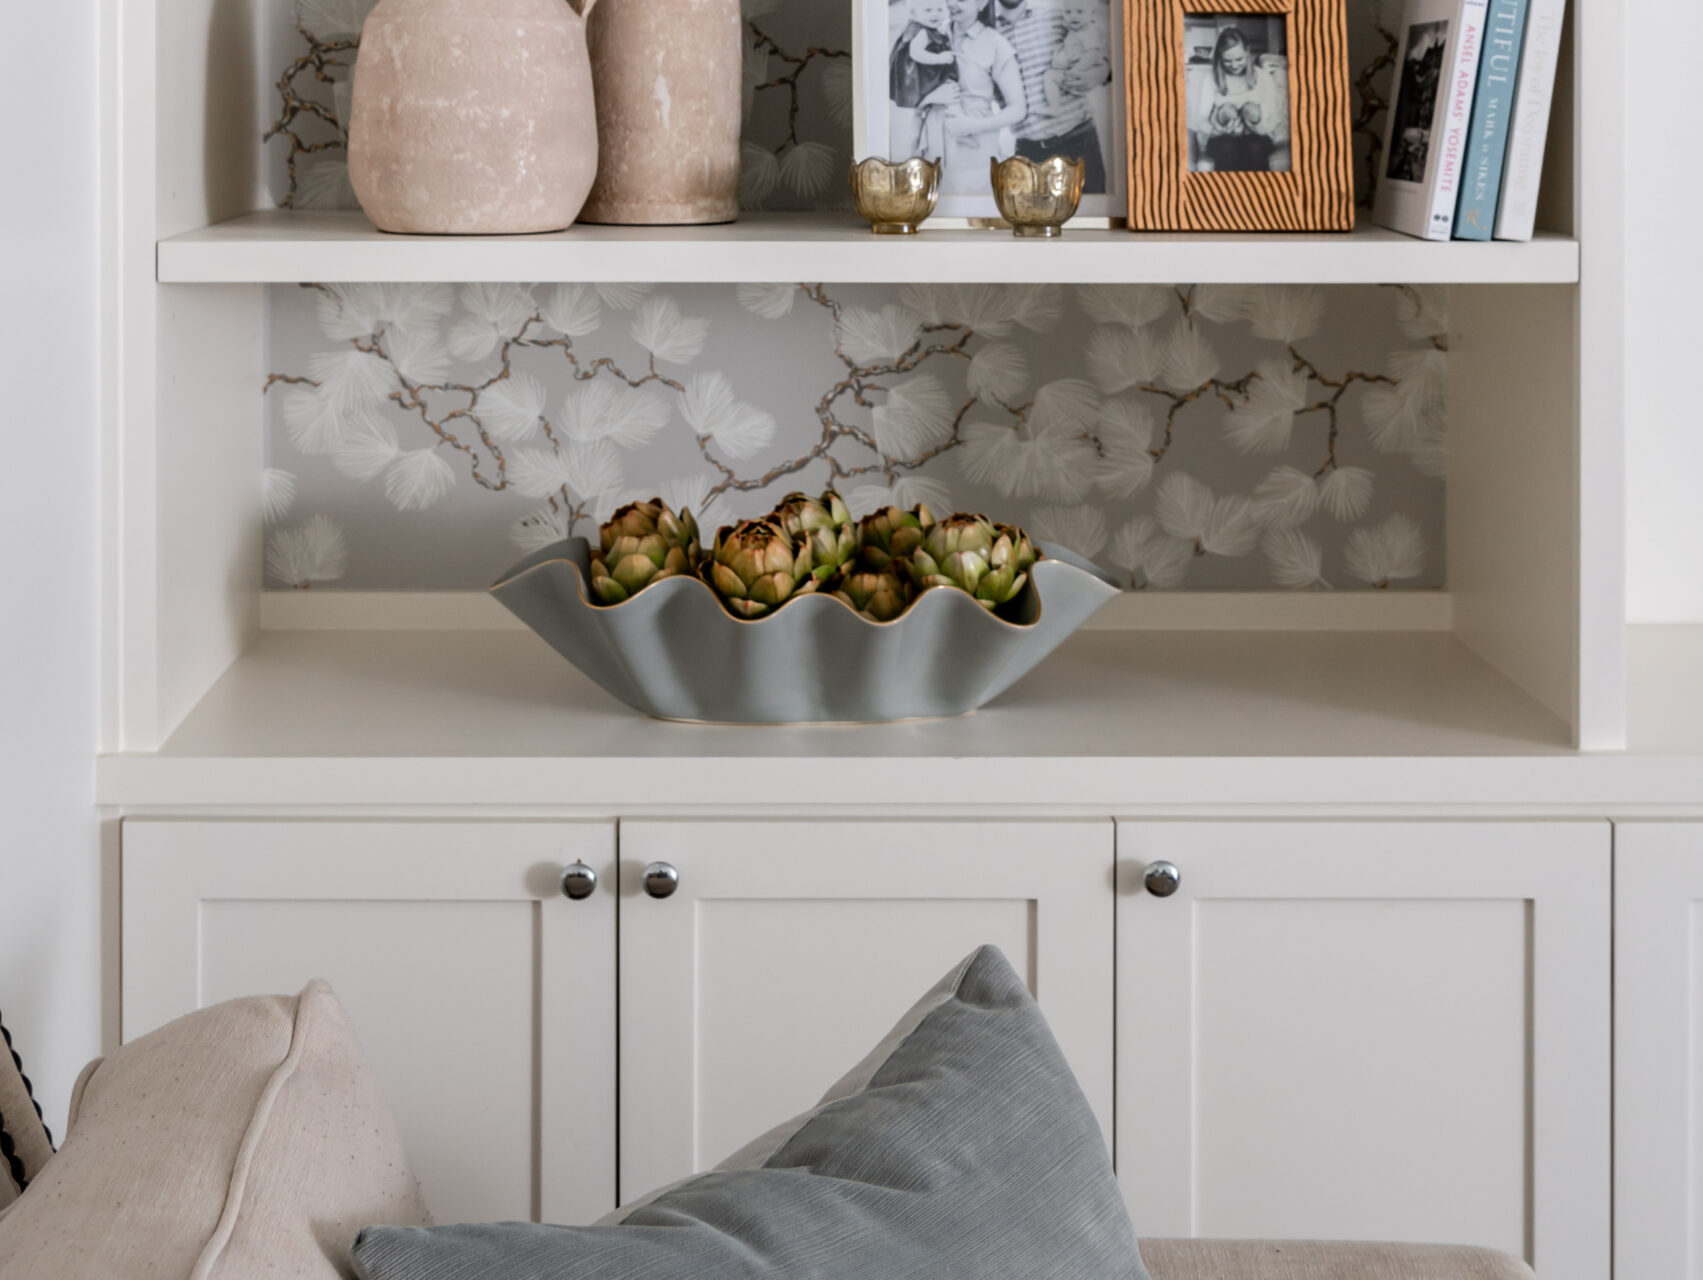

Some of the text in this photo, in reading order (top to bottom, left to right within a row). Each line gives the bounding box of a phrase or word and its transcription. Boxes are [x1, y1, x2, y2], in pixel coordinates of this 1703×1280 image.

[1460, 24, 1476, 63] ANSEL
[1483, 98, 1499, 140] MARK
[1440, 127, 1461, 192] YOSEMITE
[1475, 156, 1489, 201] SIKES
